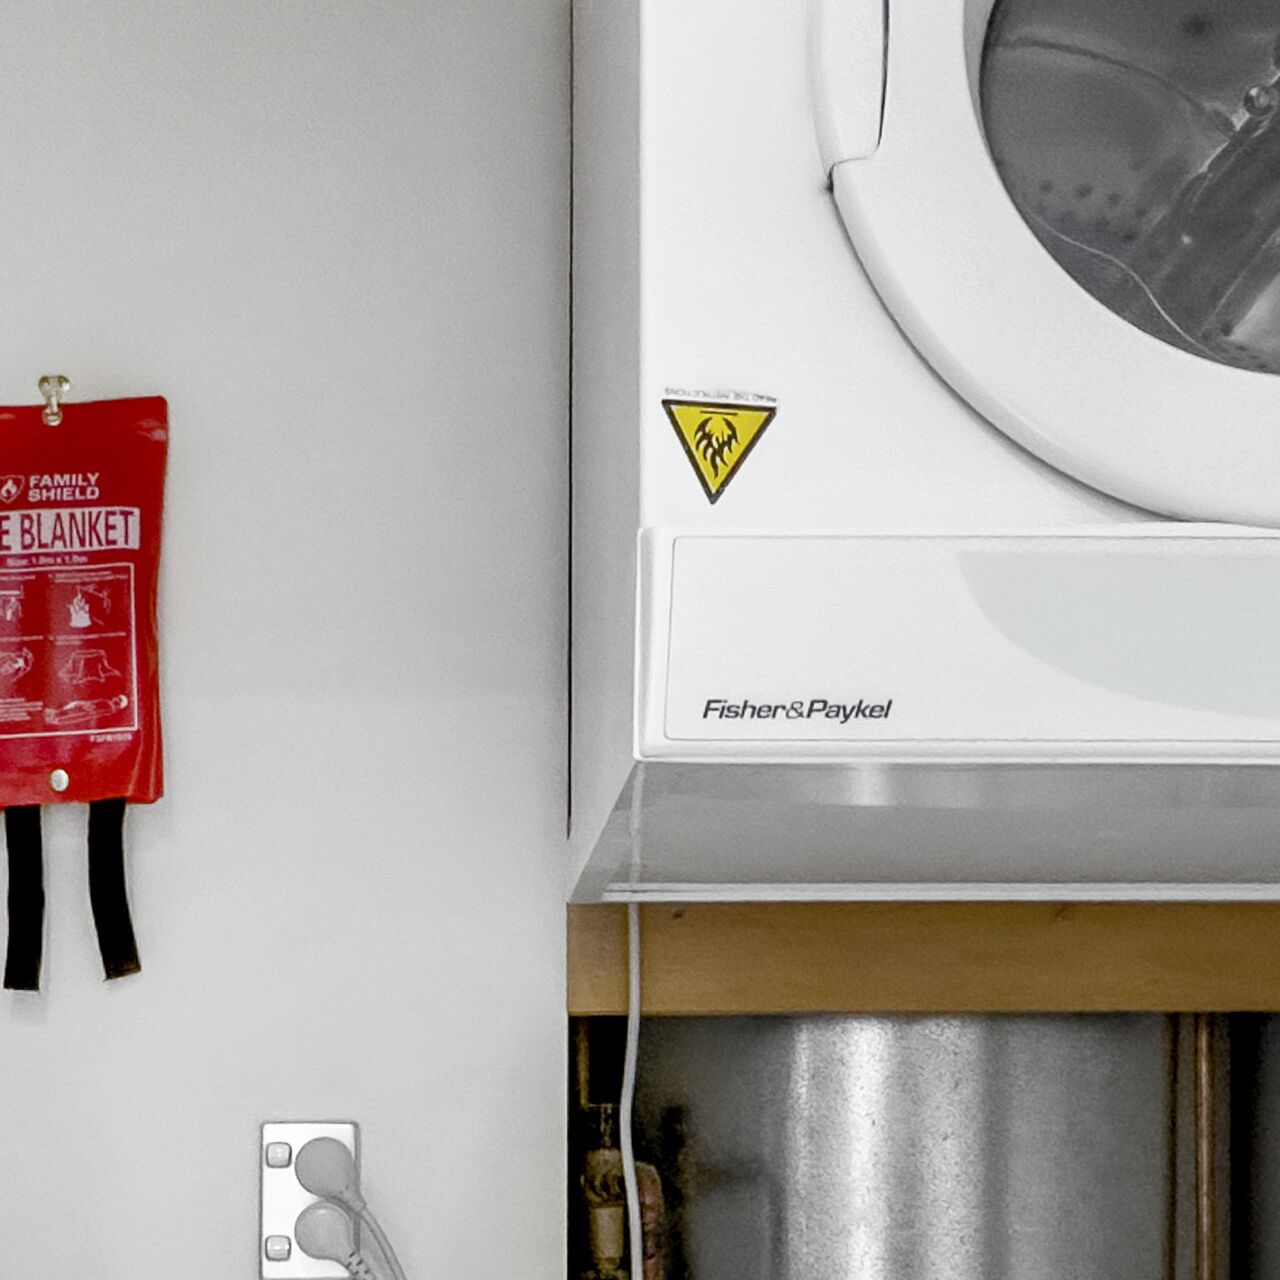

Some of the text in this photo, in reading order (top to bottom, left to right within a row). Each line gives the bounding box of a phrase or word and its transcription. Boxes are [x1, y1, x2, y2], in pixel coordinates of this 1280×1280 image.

[29, 472, 100, 489] FAMILY
[28, 486, 100, 502] SHIELD
[20, 510, 135, 551] BLANKET
